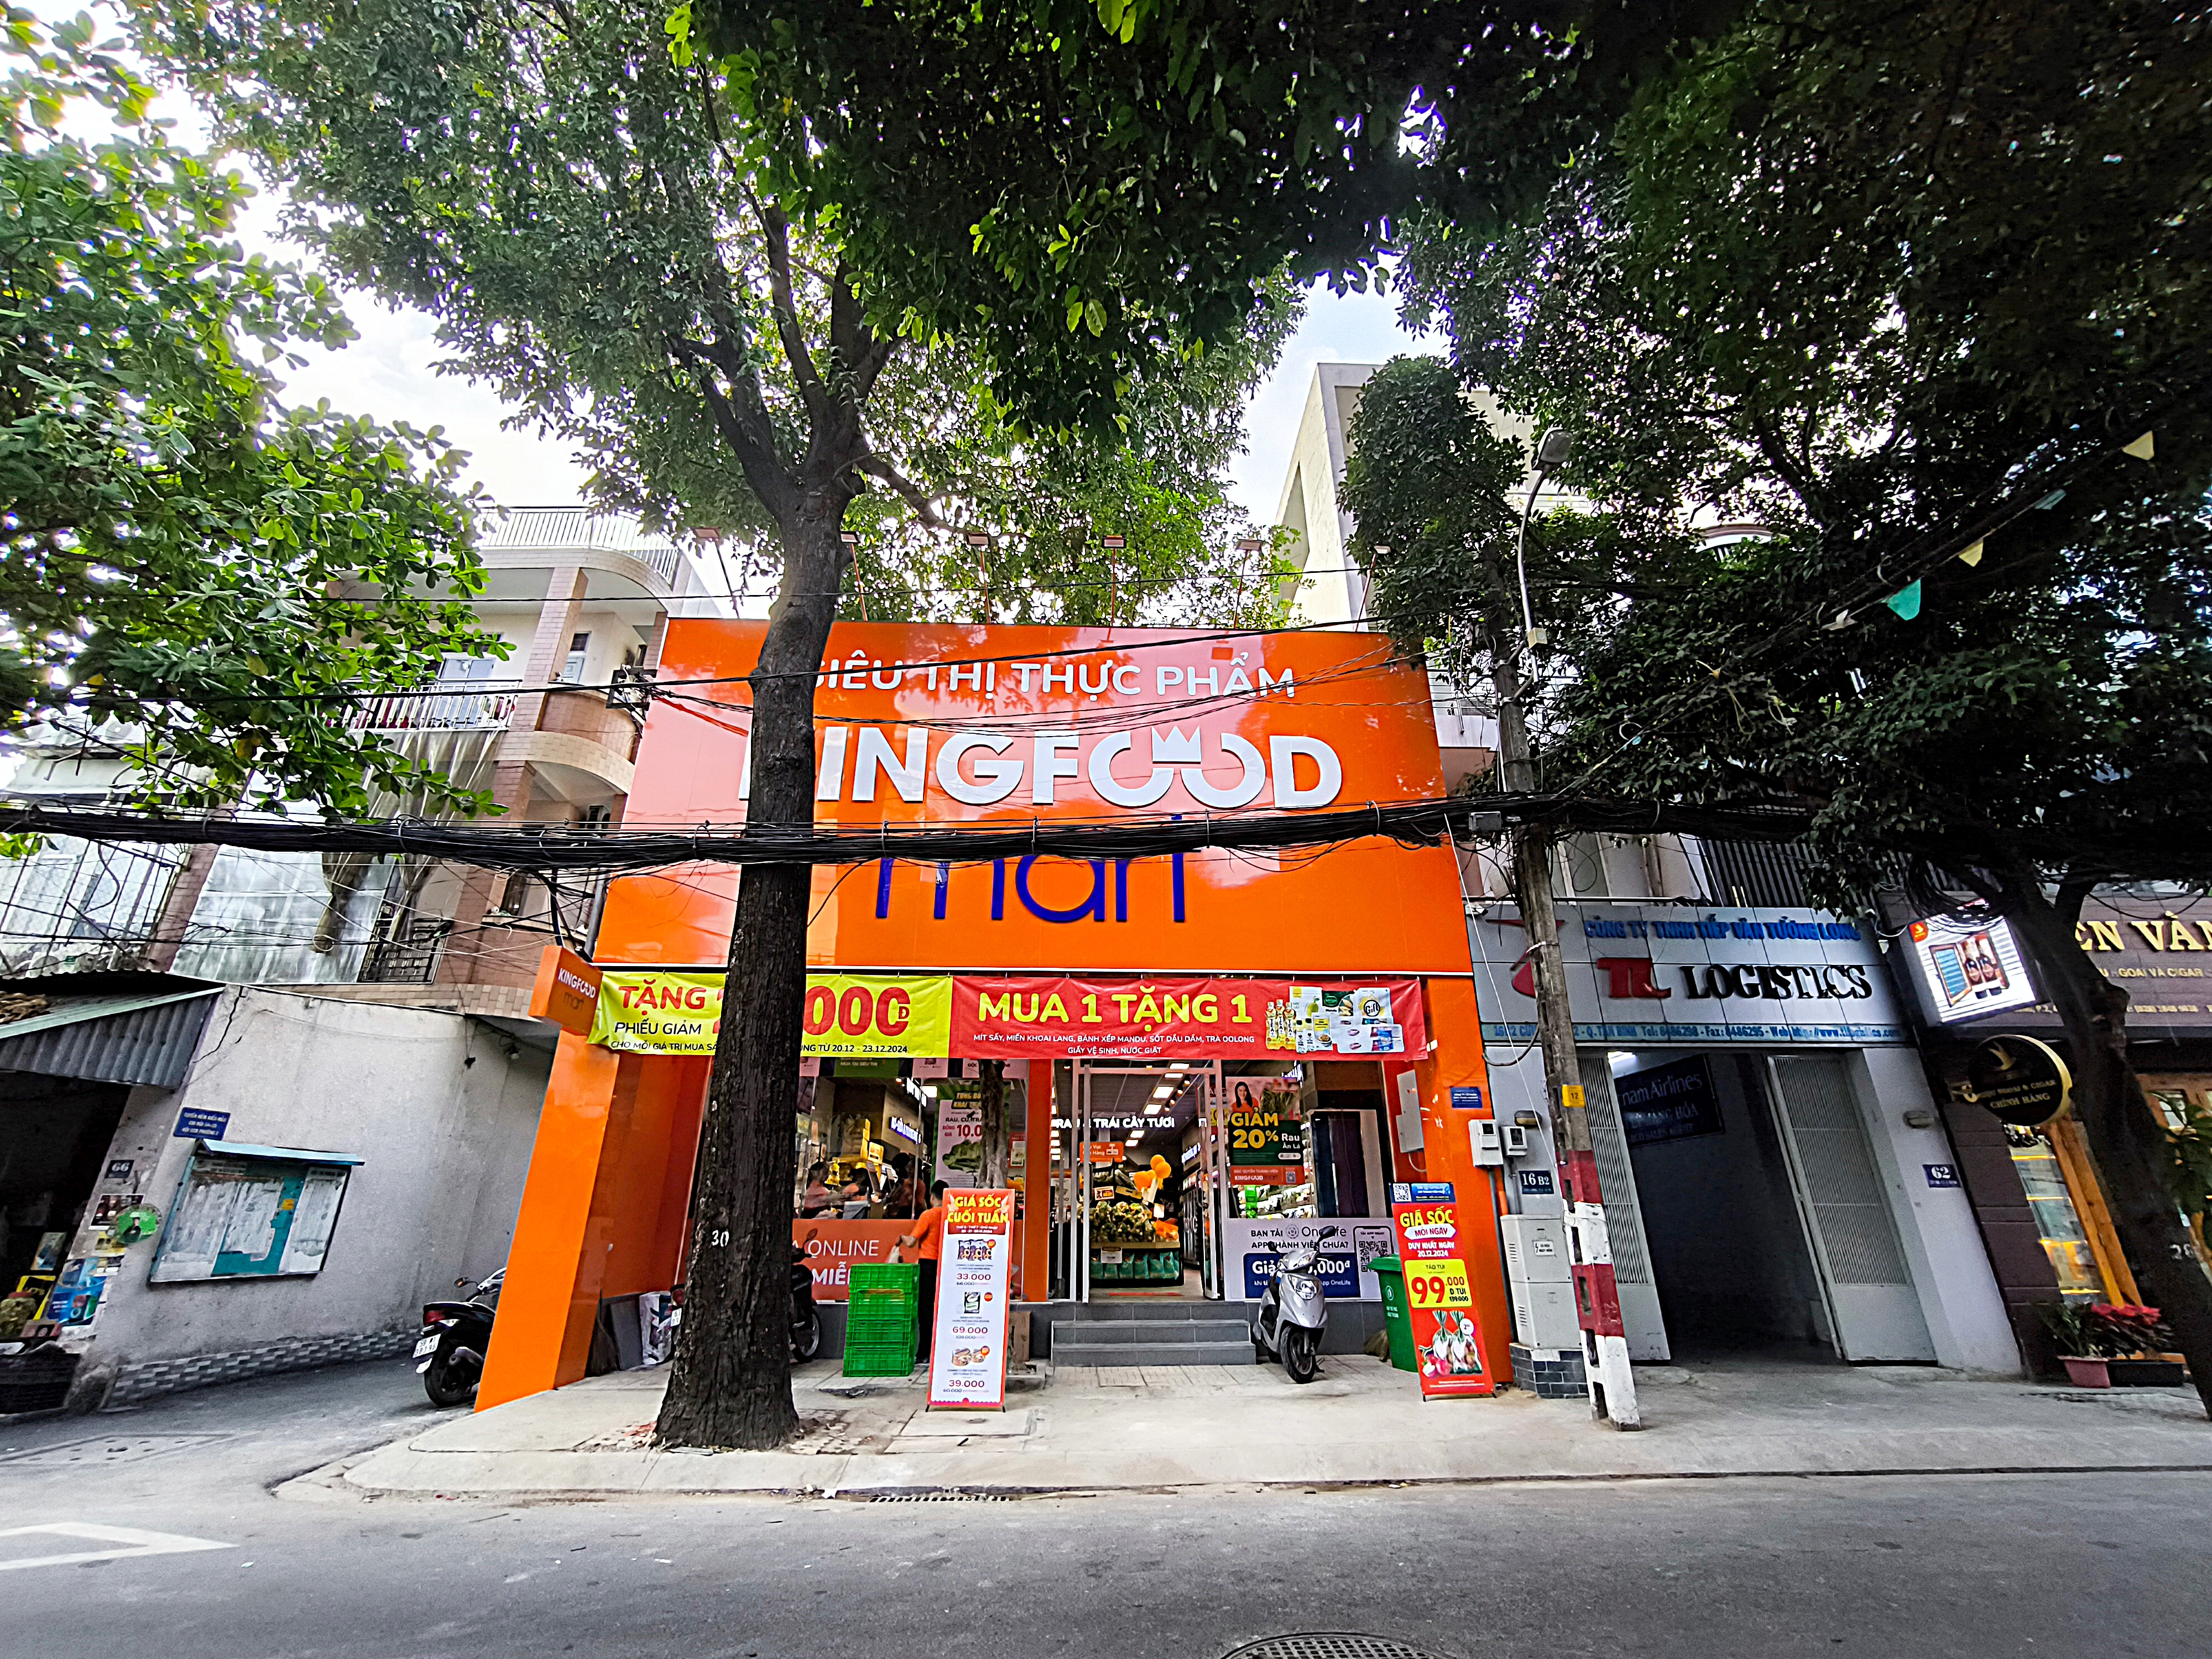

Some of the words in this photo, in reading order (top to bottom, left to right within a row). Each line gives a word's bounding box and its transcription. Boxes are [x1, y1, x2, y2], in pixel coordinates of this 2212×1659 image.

[926, 660, 996, 700] THỊ
[1011, 659, 1141, 702] THỰC
[1156, 651, 1296, 698] PHẨM
[739, 725, 1342, 808] INGFOOD
[1627, 920, 1648, 938] TY
[1651, 921, 1697, 939] TNHH
[1817, 922, 1861, 940] LONG
[2167, 968, 2203, 977] CIGAR
[558, 967, 596, 999] KINGFOOD
[1679, 963, 1874, 1000] LOGISTICS
[618, 978, 707, 1016] TẶNG
[978, 992, 1070, 1024] MUA
[1081, 993, 1102, 1024] 1
[1112, 984, 1219, 1032] TẶNG
[1230, 993, 1253, 1024] 1
[614, 1018, 659, 1034] PHIẾU
[662, 1020, 702, 1035] GIẢM
[989, 1032, 1005, 1041] SẤY,
[1101, 1034, 1116, 1042] XẾP
[1150, 1034, 1164, 1042] SỐT
[653, 1041, 667, 1050] GIÁ
[669, 1043, 682, 1052] TRỊ
[818, 1042, 831, 1051] TỪ
[1087, 1046, 1097, 1055] VỆ
[1650, 1073, 1703, 1099] Airlines
[1093, 1115, 1120, 1129] TRÁI
[1122, 1115, 1147, 1129] CÂY
[1147, 1116, 1175, 1129] TƯƠI
[1231, 1107, 1279, 1126] GIẢM
[1233, 1129, 1279, 1149] 20%
[1281, 1133, 1300, 1141] Rau
[112, 1162, 130, 1172] 66
[1931, 1166, 1950, 1178] 62
[1522, 1173, 1536, 1185] 16
[1538, 1176, 1550, 1185] B2
[954, 1194, 977, 1207] GIÁ
[978, 1193, 1001, 1208] SỐC
[947, 1208, 975, 1223] CUỐI
[1400, 1209, 1425, 1227] GIÁ
[1426, 1205, 1455, 1225] SỐC
[711, 1229, 729, 1247] 30
[1251, 1230, 1268, 1239] BẠN
[808, 1239, 880, 1257] ONLINE
[1322, 1240, 1349, 1249] CHƯA?
[1408, 1241, 1421, 1250] DUY
[1417, 1249, 1449, 1258] 20.12.2024
[811, 1261, 851, 1285] MIỄ
